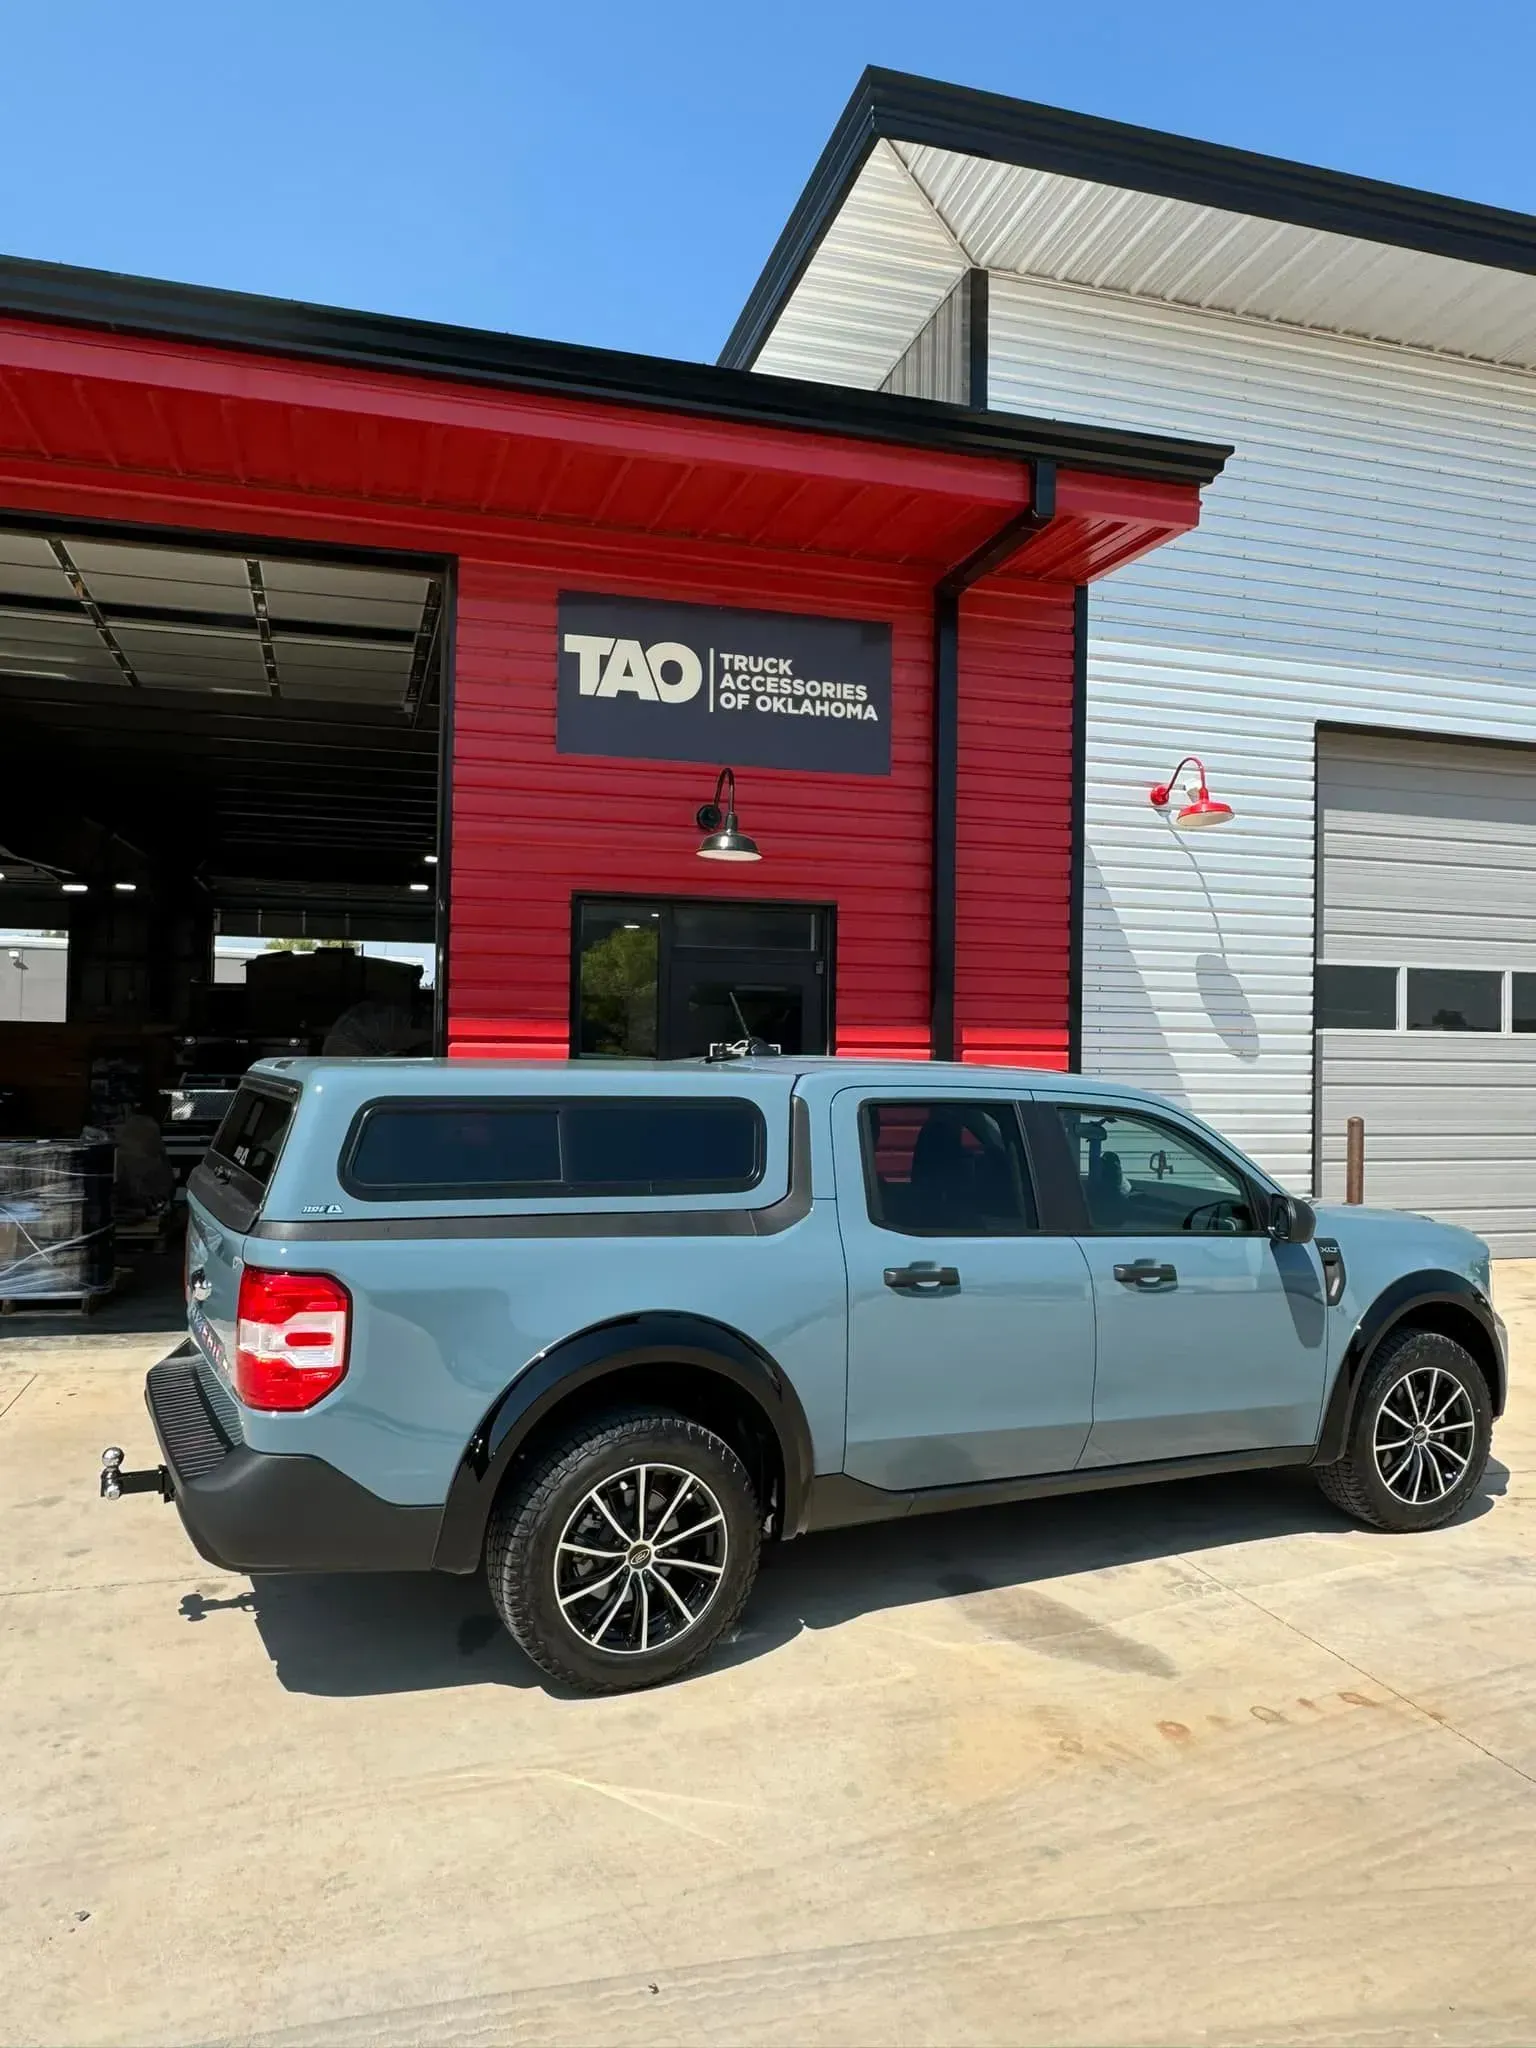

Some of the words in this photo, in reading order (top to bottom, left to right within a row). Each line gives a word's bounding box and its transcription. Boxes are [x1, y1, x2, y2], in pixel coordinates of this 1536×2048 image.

[564, 633, 703, 703] TAO
[719, 652, 793, 676] TRUCK
[719, 674, 868, 701] ACCESSORIES
[719, 692, 750, 710] OF
[756, 694, 878, 721] OKLAHOMA
